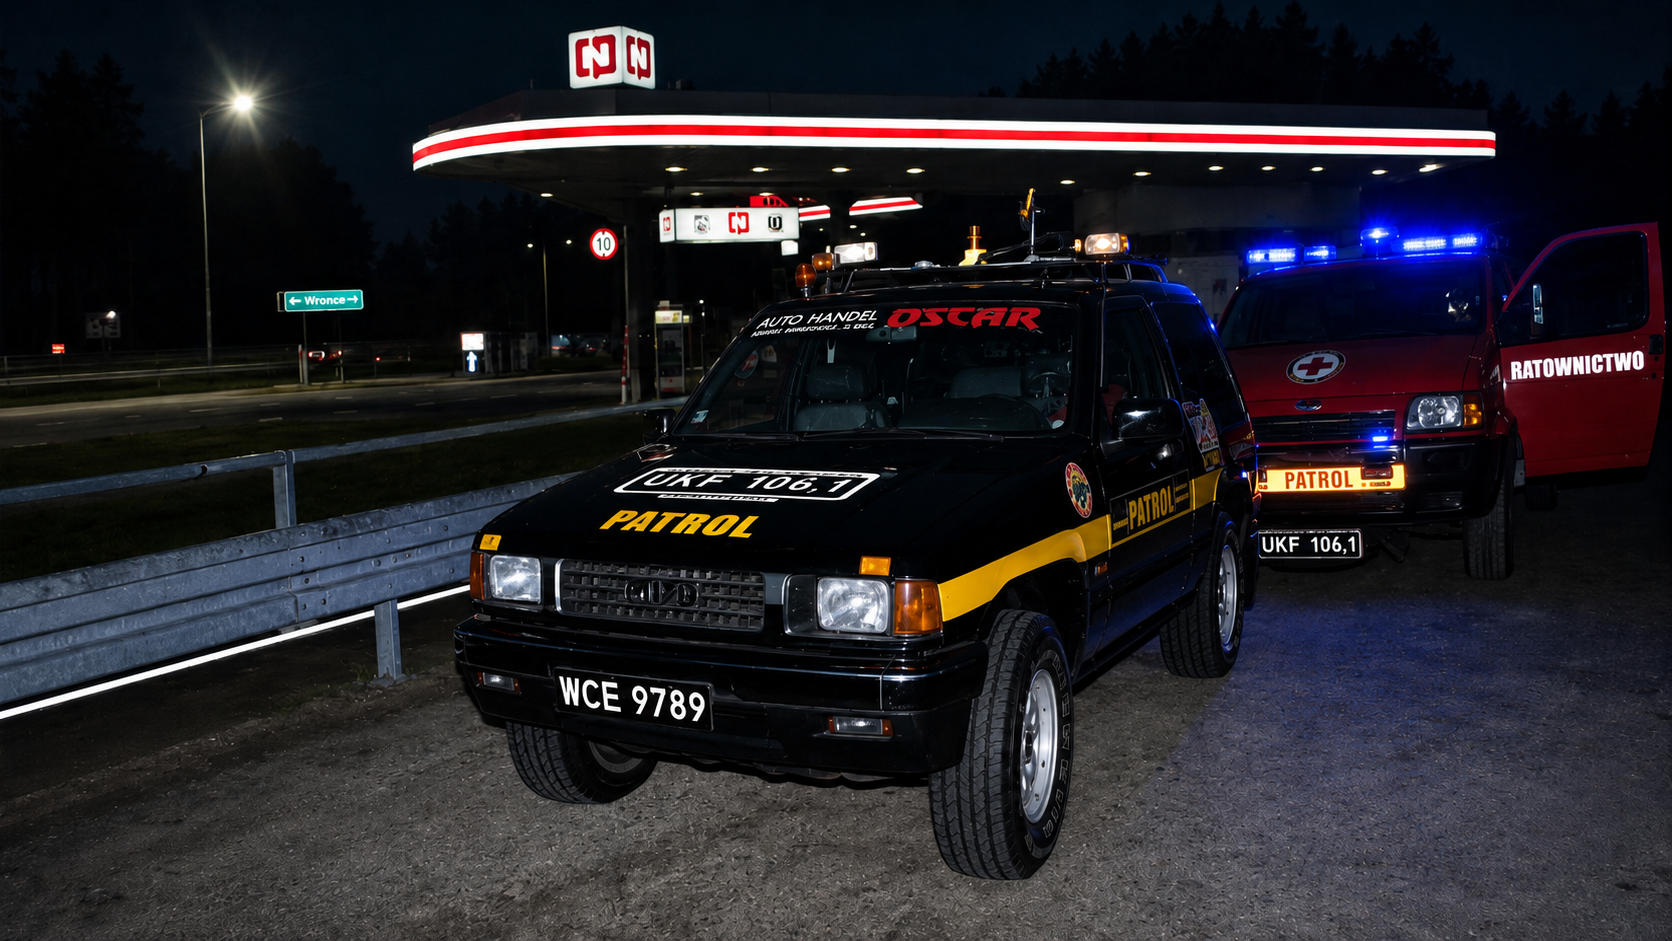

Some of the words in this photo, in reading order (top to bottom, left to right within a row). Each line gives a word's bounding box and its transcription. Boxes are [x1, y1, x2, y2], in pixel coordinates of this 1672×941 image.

[596, 237, 611, 251] 10
[304, 295, 346, 306] Wronce
[756, 314, 804, 330] AUTO
[807, 309, 878, 325] HANDEL
[887, 307, 1041, 331] OSCAR
[1510, 350, 1645, 380] RATOWNICTWO
[643, 474, 733, 489] UKF
[746, 474, 852, 494] 106,1
[1284, 470, 1353, 490] PATROL
[1128, 485, 1175, 530] PATROL
[599, 509, 760, 539] PATROL
[1262, 536, 1300, 553] UKF
[1310, 536, 1356, 555] 106,1
[558, 675, 622, 713] WCE
[631, 685, 706, 722] 9789
